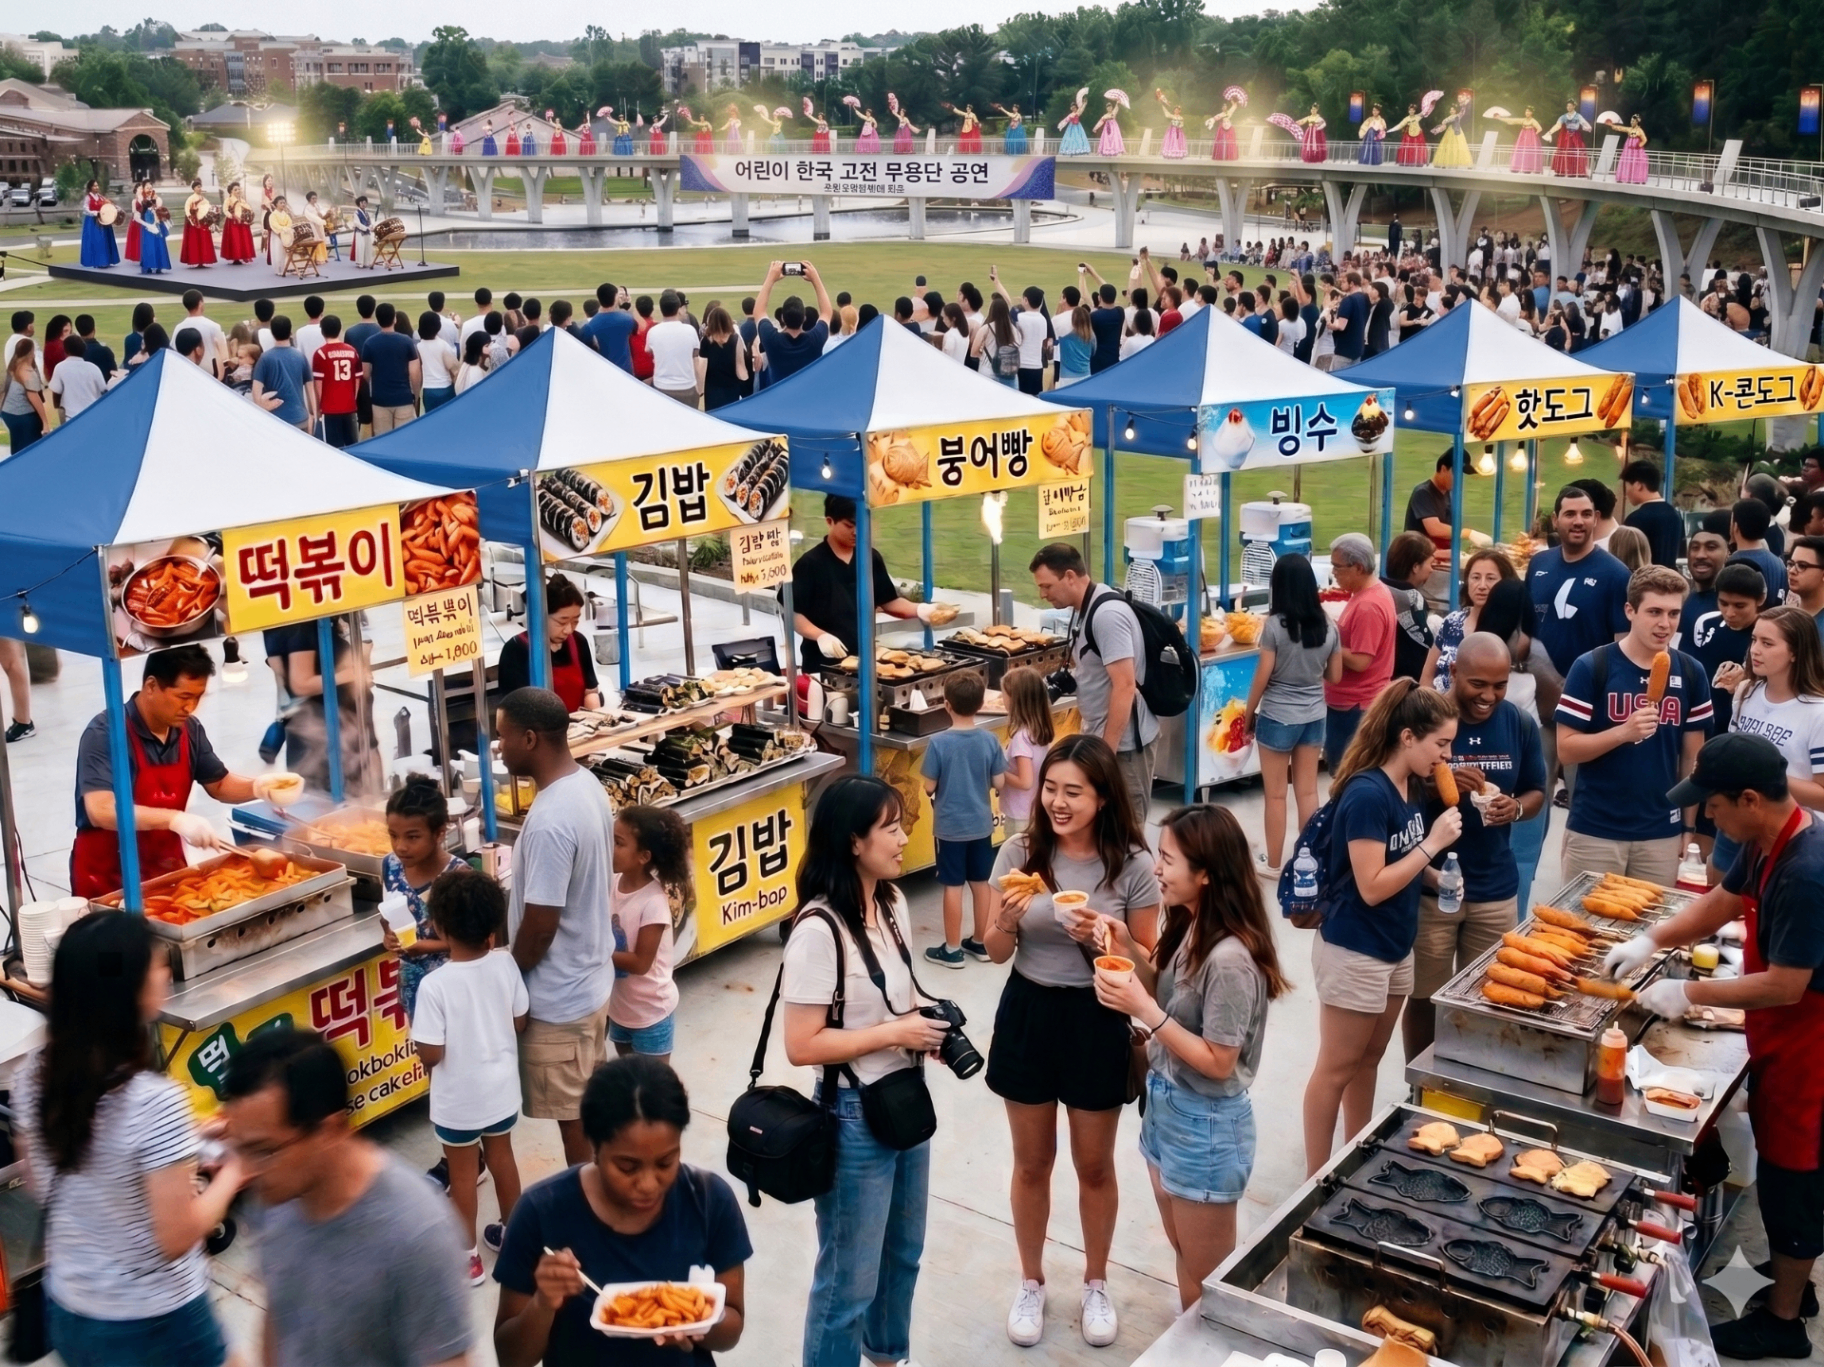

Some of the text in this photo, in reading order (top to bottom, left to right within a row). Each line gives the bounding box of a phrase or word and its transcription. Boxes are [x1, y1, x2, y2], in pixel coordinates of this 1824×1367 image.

[735, 160, 988, 183] 어린이 한국 고전 무용단 공연
[333, 360, 351, 381] 13
[1710, 375, 1797, 410] K-콘도그
[1271, 403, 1338, 456] 빙수
[1515, 388, 1593, 430] 핫도그
[937, 428, 1033, 486] 붕어빵
[632, 461, 710, 531] 김밥
[238, 522, 393, 610] 떡볶이
[709, 809, 792, 896] 김밥
[346, 1094, 365, 1116] se
